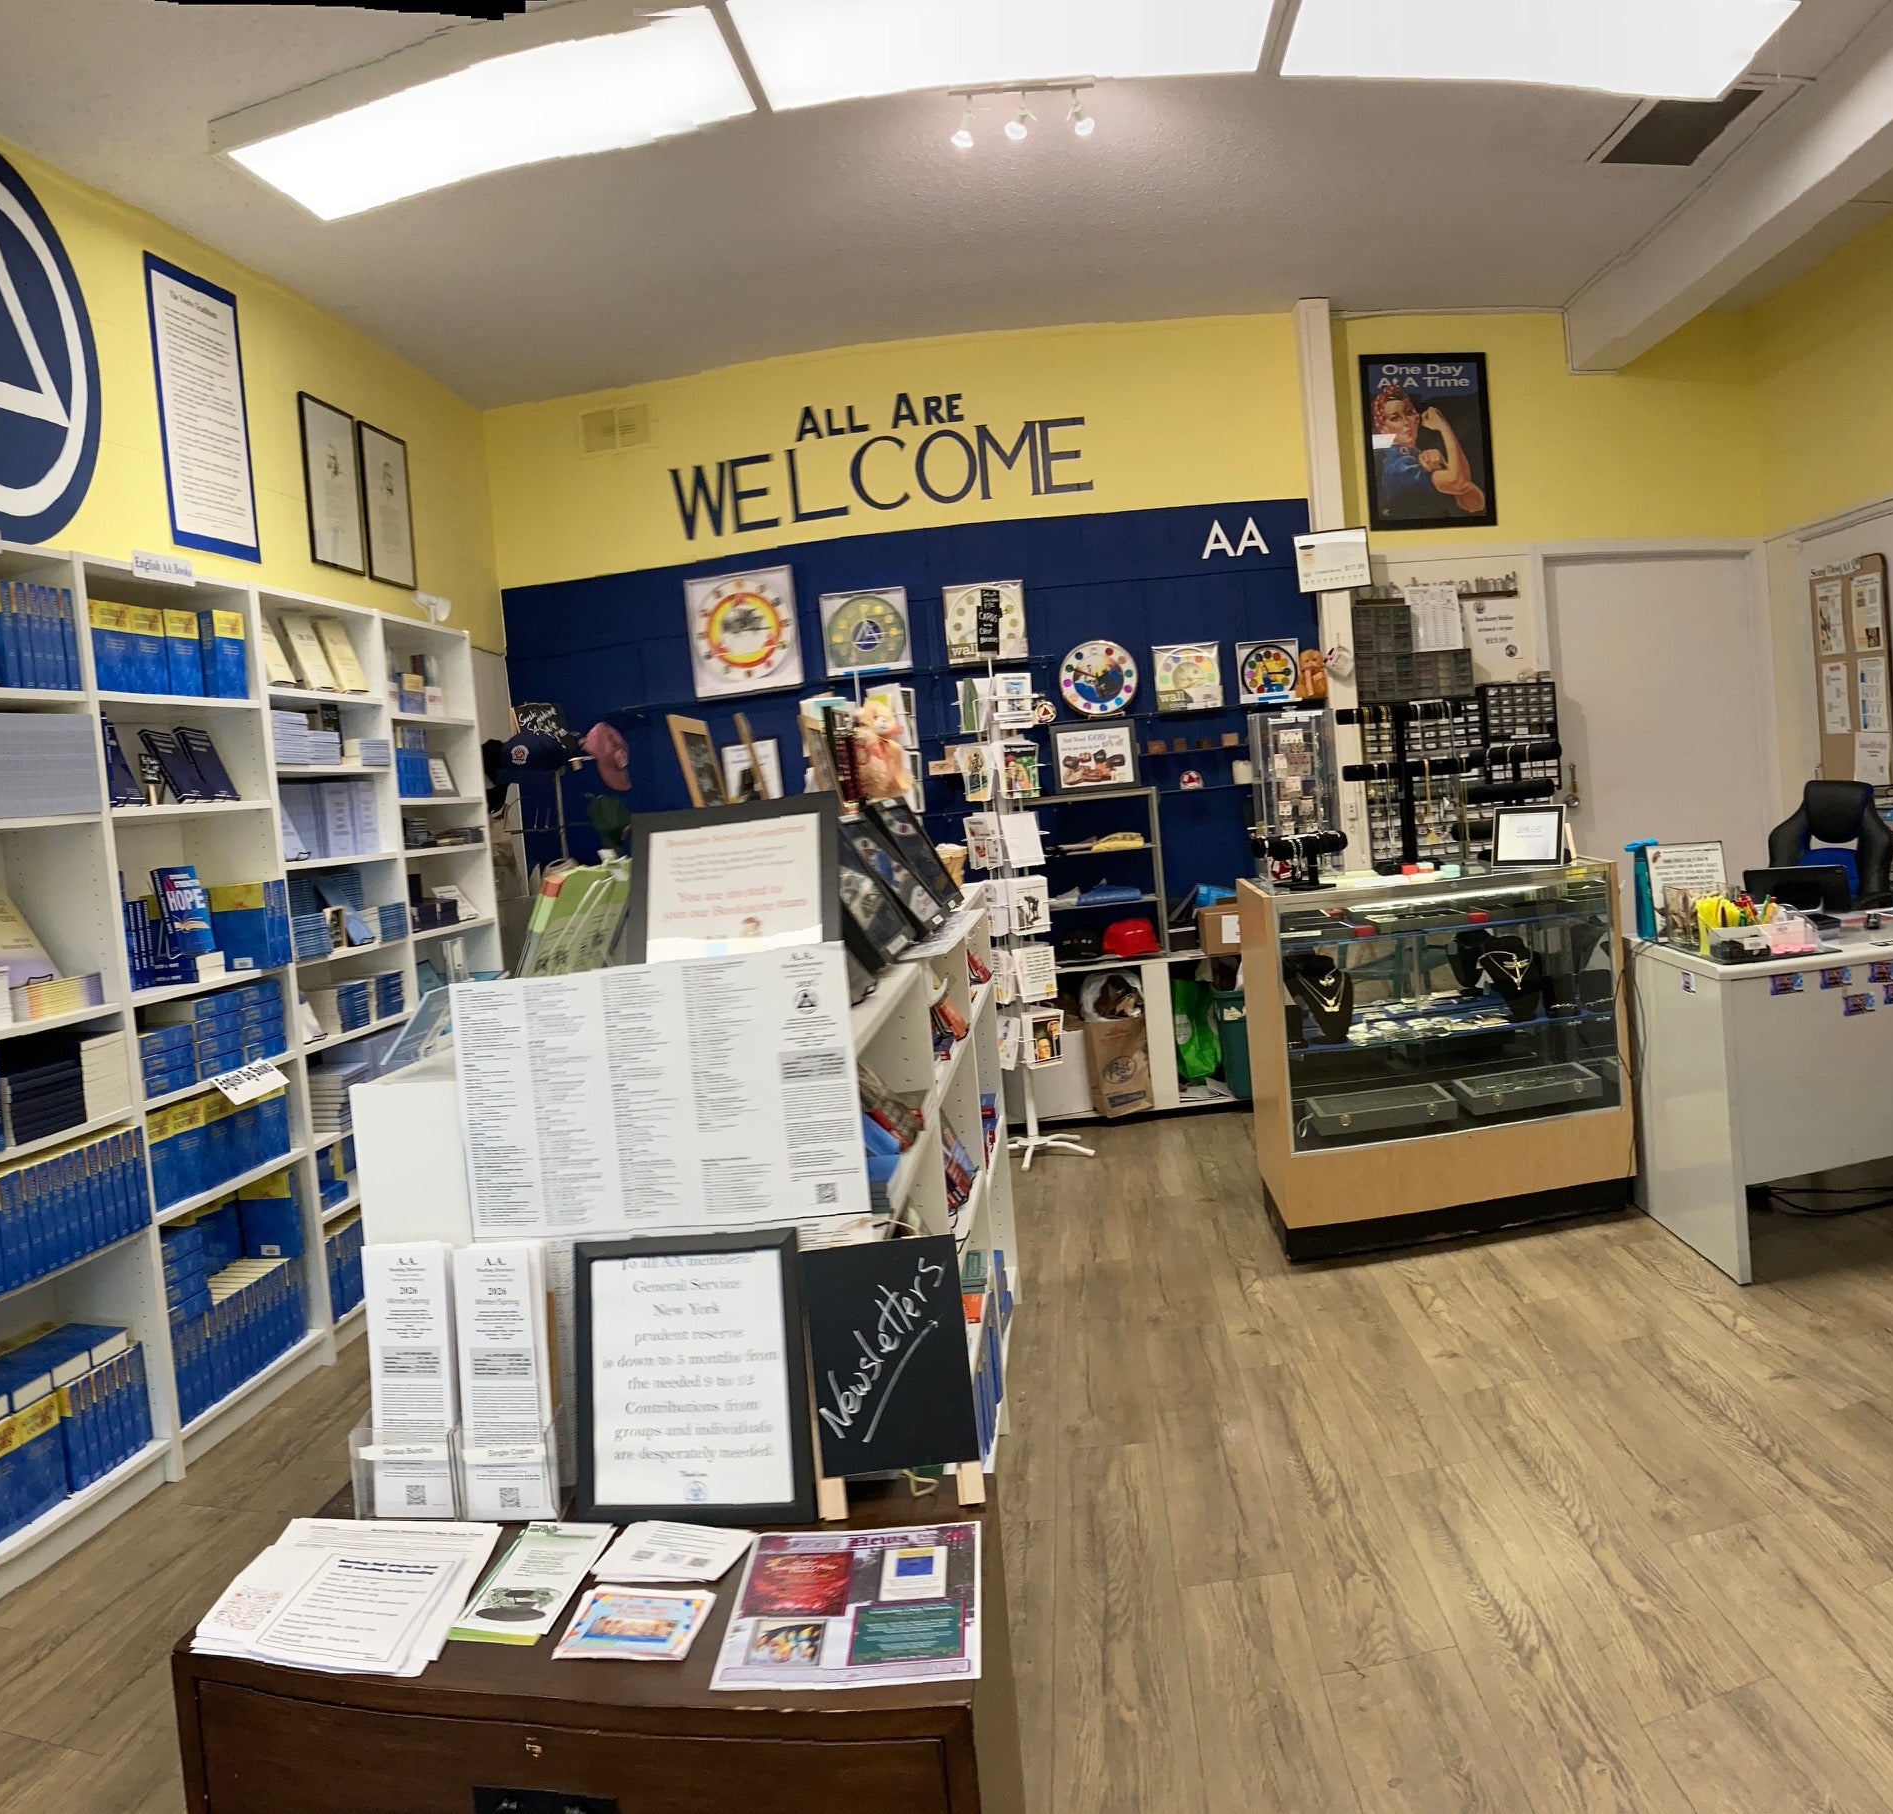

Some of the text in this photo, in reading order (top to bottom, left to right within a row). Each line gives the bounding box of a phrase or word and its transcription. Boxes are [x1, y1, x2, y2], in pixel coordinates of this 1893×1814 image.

[1377, 377, 1470, 388] At A Time
[1382, 364, 1463, 376] One Day
[669, 416, 1094, 541] WELCOME
[1202, 517, 1270, 559] AA
[165, 887, 205, 912] HOPE
[819, 1257, 946, 1438] Newsletters
